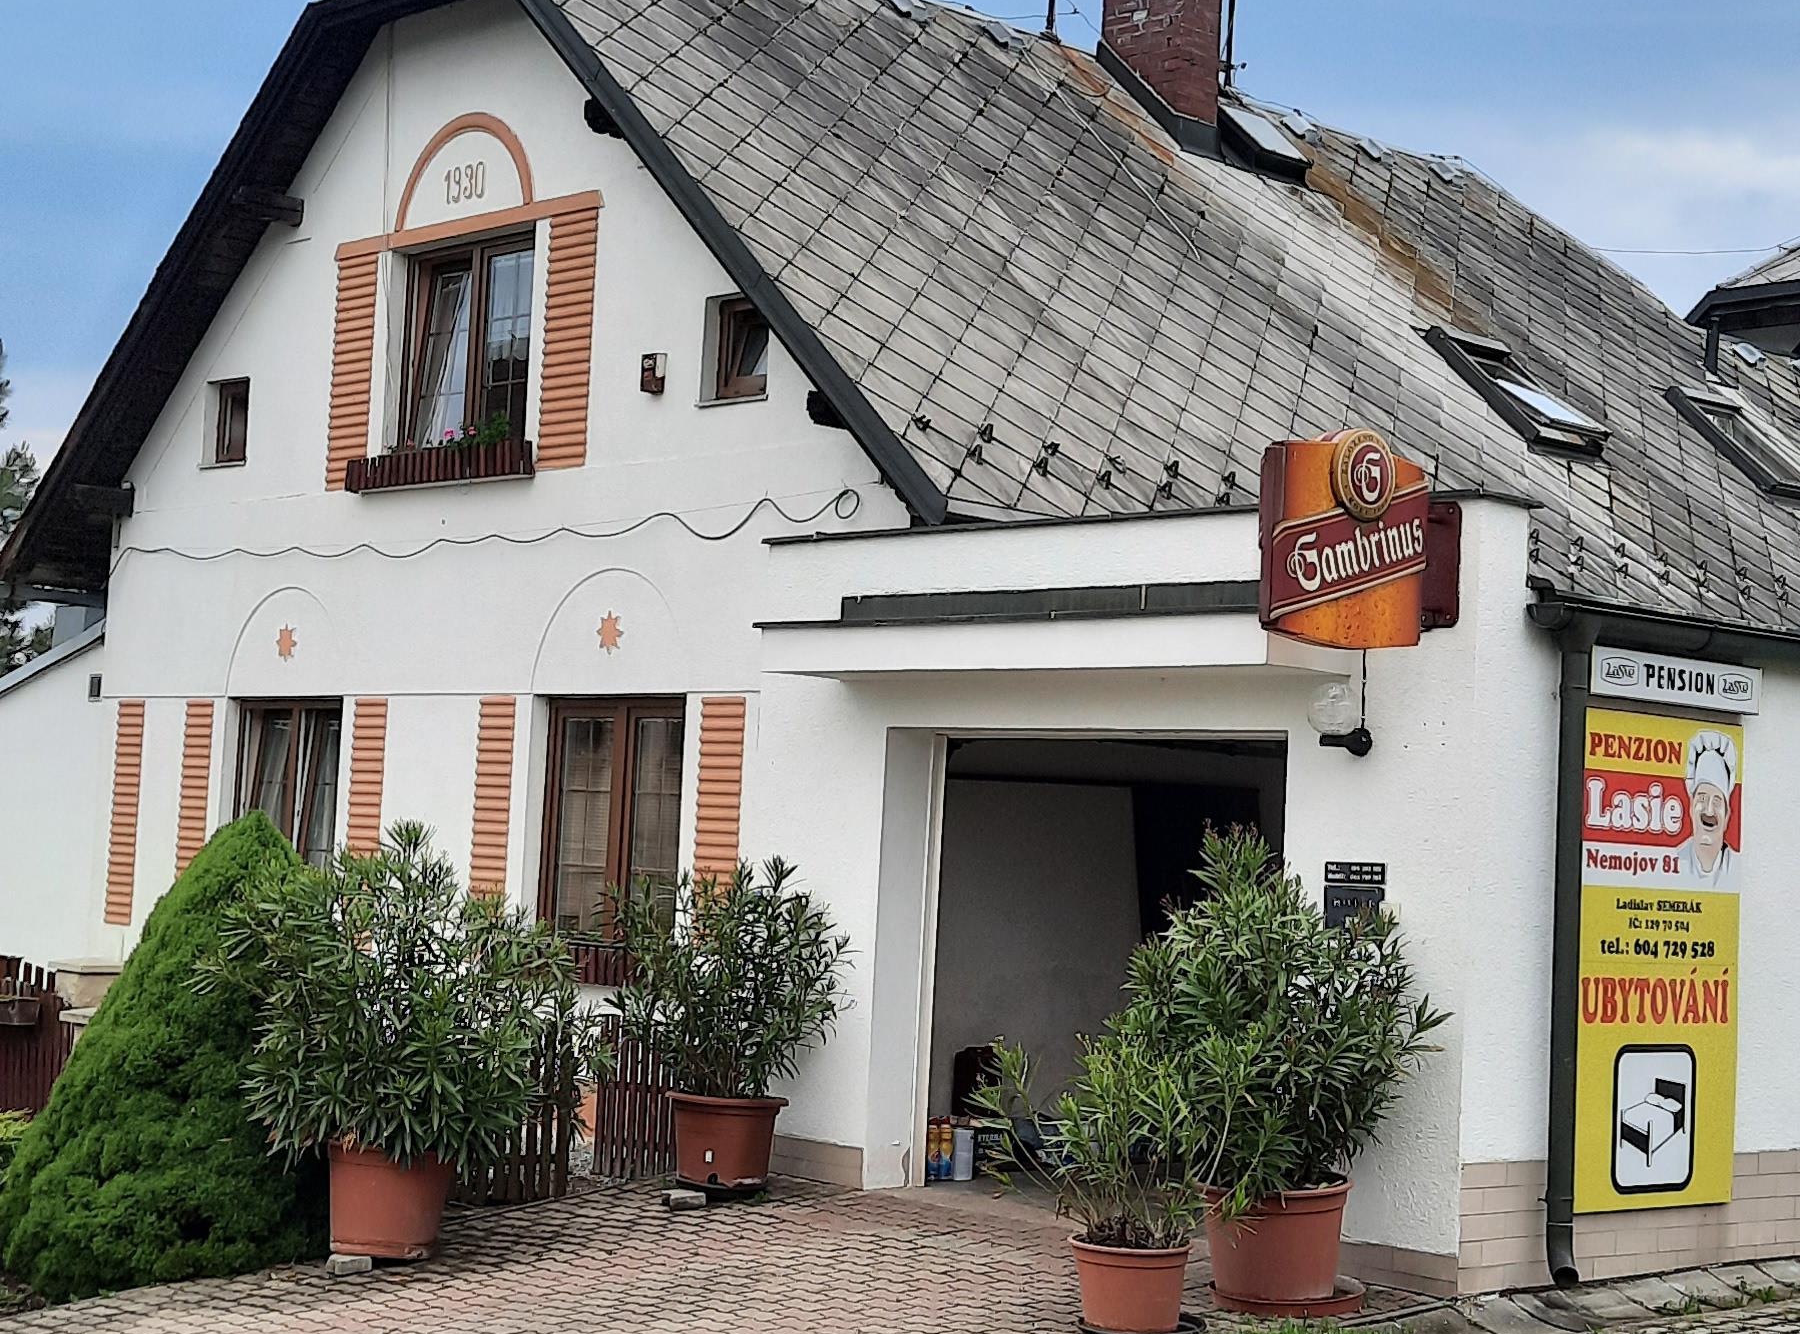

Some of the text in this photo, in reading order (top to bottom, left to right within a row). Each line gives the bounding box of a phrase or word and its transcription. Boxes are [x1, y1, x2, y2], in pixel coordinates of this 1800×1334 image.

[444, 160, 485, 205] 1930
[1286, 517, 1424, 592] Gambrinus
[1643, 663, 1715, 695] PENSION
[1589, 731, 1683, 765] PENZION
[1585, 777, 1684, 835] Lasie
[1586, 848, 1681, 876] Nemojov 81
[1616, 898, 1703, 914] Ladislav SEMERÁK
[1662, 920, 1672, 932] 70
[1600, 937, 1715, 959] tel.: 604 729 528
[1581, 967, 1729, 1025] UBYTOVÁNÍ
